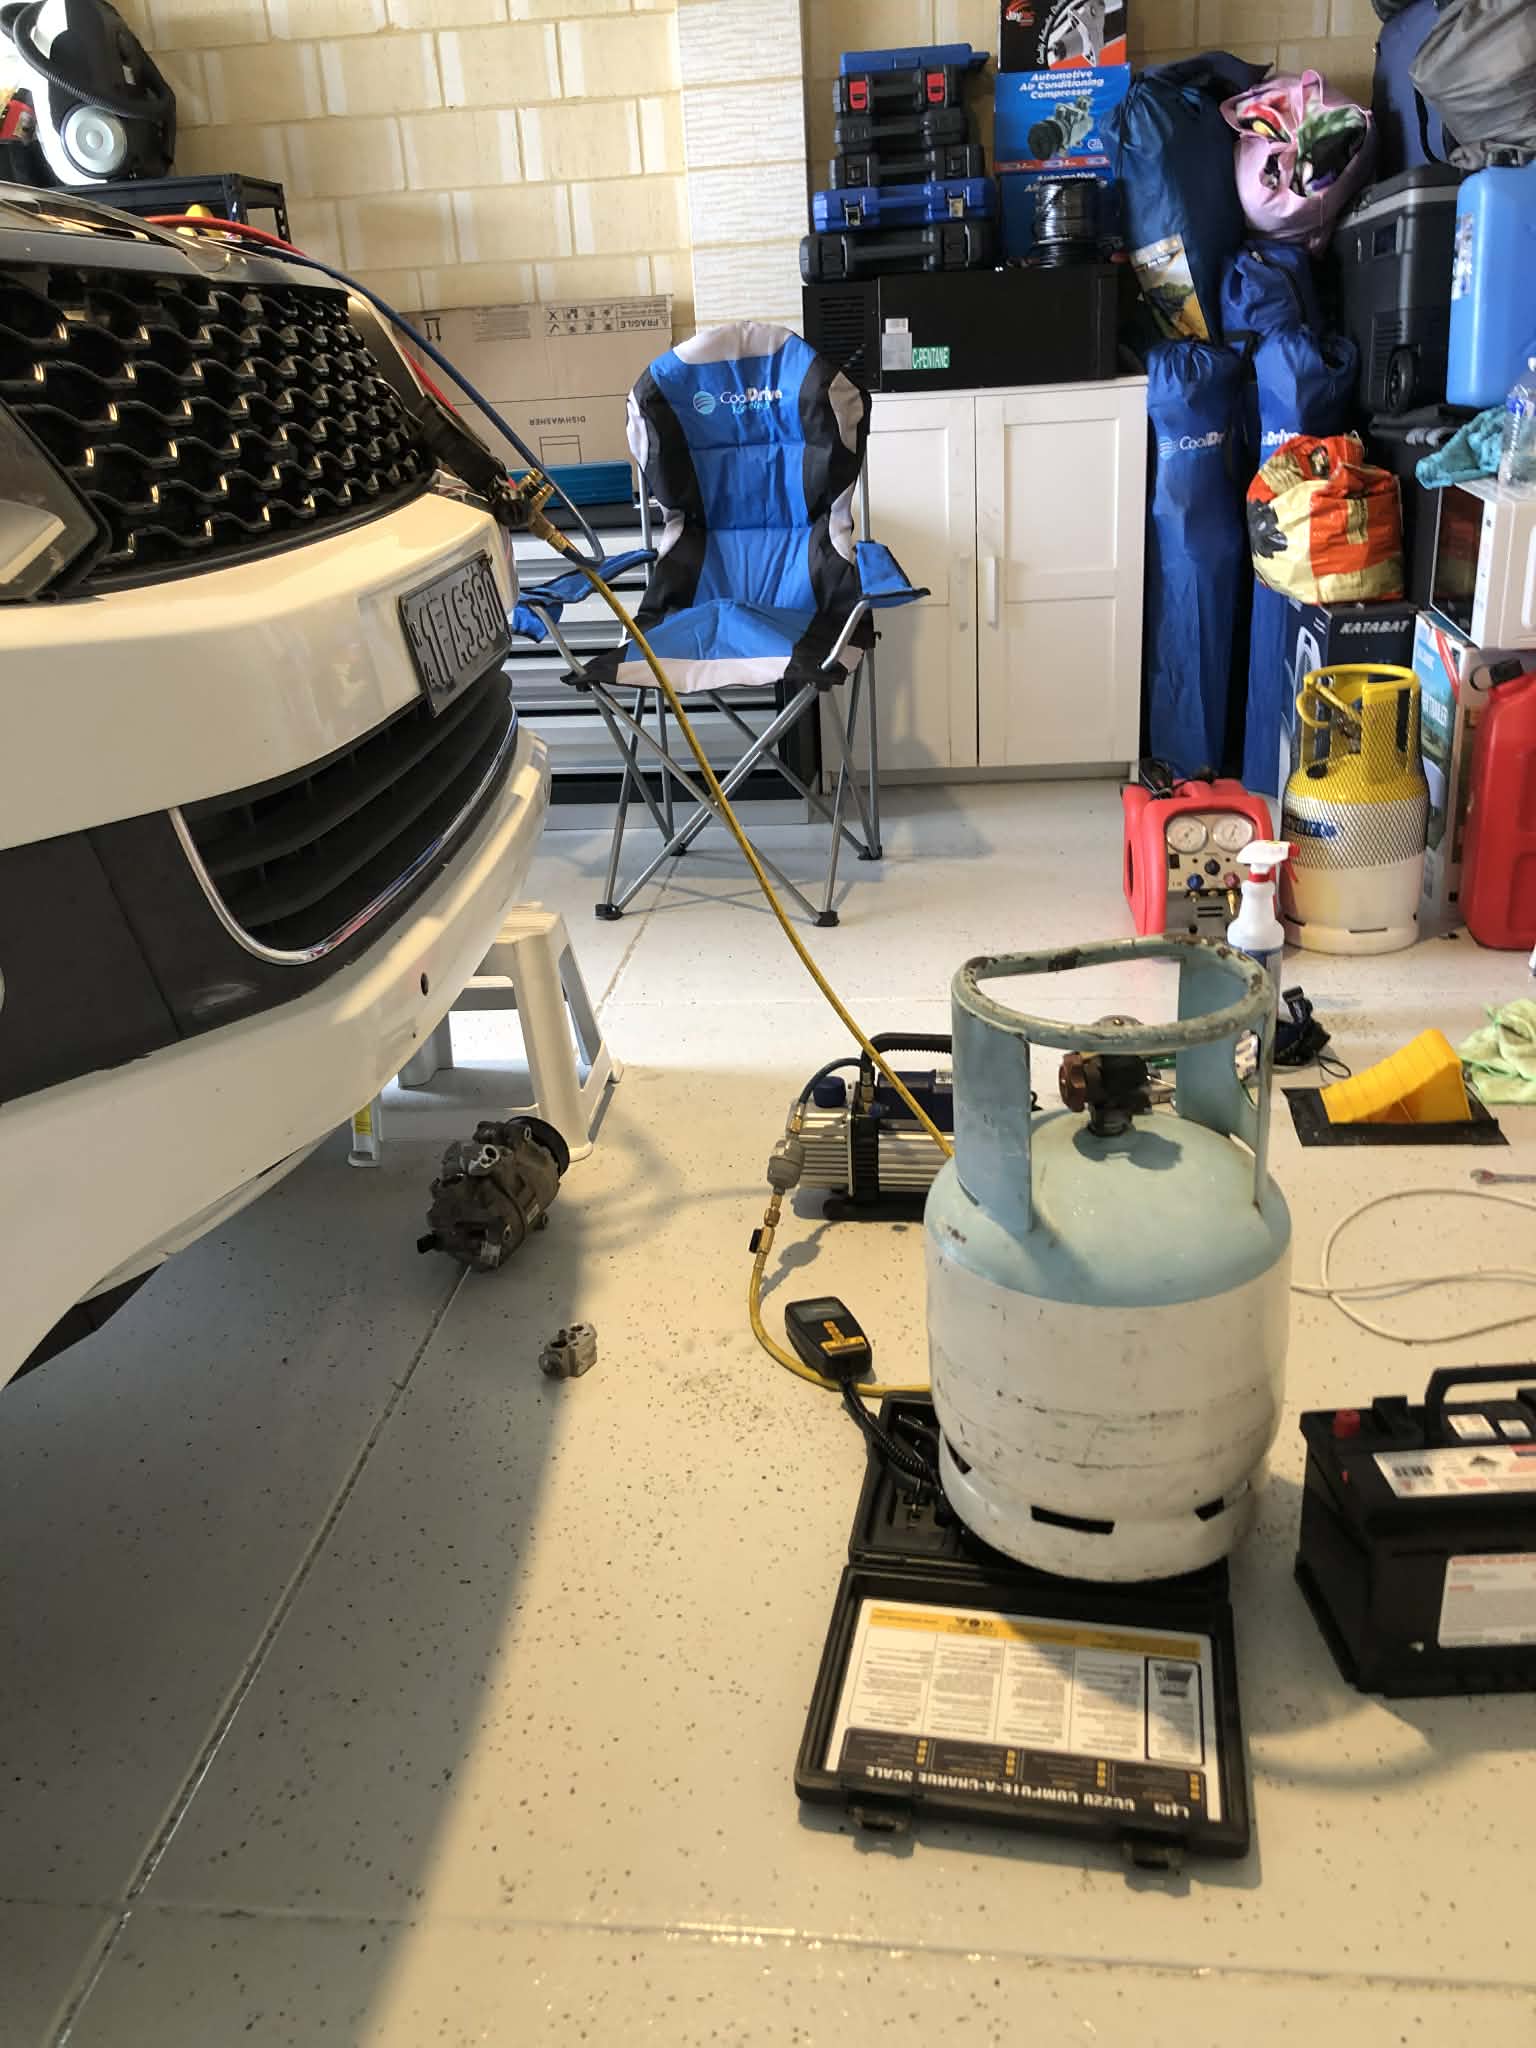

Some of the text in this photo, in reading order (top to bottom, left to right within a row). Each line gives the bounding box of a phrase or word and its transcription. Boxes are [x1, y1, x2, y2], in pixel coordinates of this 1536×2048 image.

[1031, 70, 1093, 81] Automotive
[1019, 79, 1105, 91] Air Conditioning
[1030, 89, 1093, 99] Compressor
[620, 319, 659, 329] FRAGILE
[529, 415, 586, 426] DISHWASHER
[1340, 620, 1410, 634] KATABAT
[865, 1765, 913, 1783] SCALE
